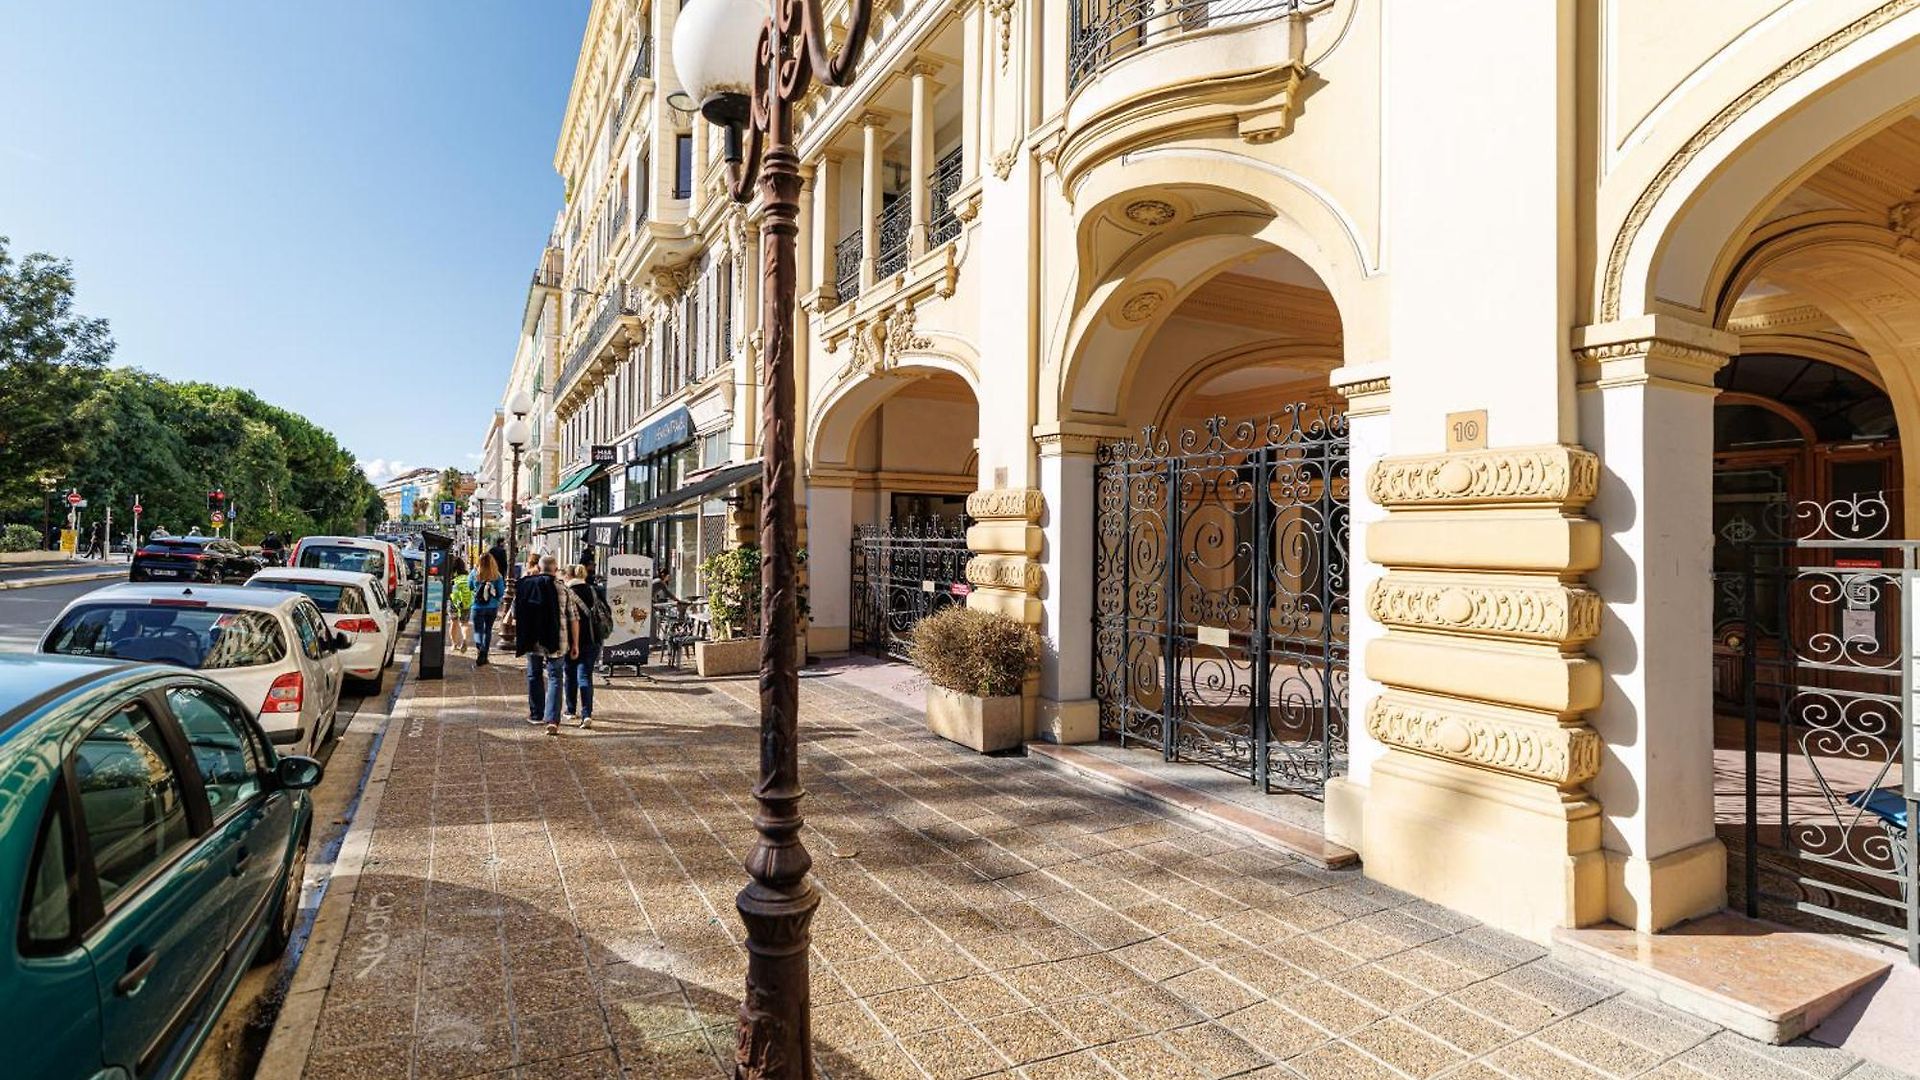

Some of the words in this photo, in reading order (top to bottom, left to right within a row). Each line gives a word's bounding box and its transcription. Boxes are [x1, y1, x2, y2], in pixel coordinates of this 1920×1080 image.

[1453, 420, 1480, 442] 10
[444, 504, 451, 513] P
[431, 552, 440, 565] P
[610, 567, 651, 577] BUBBLE
[629, 579, 649, 588] TEA
